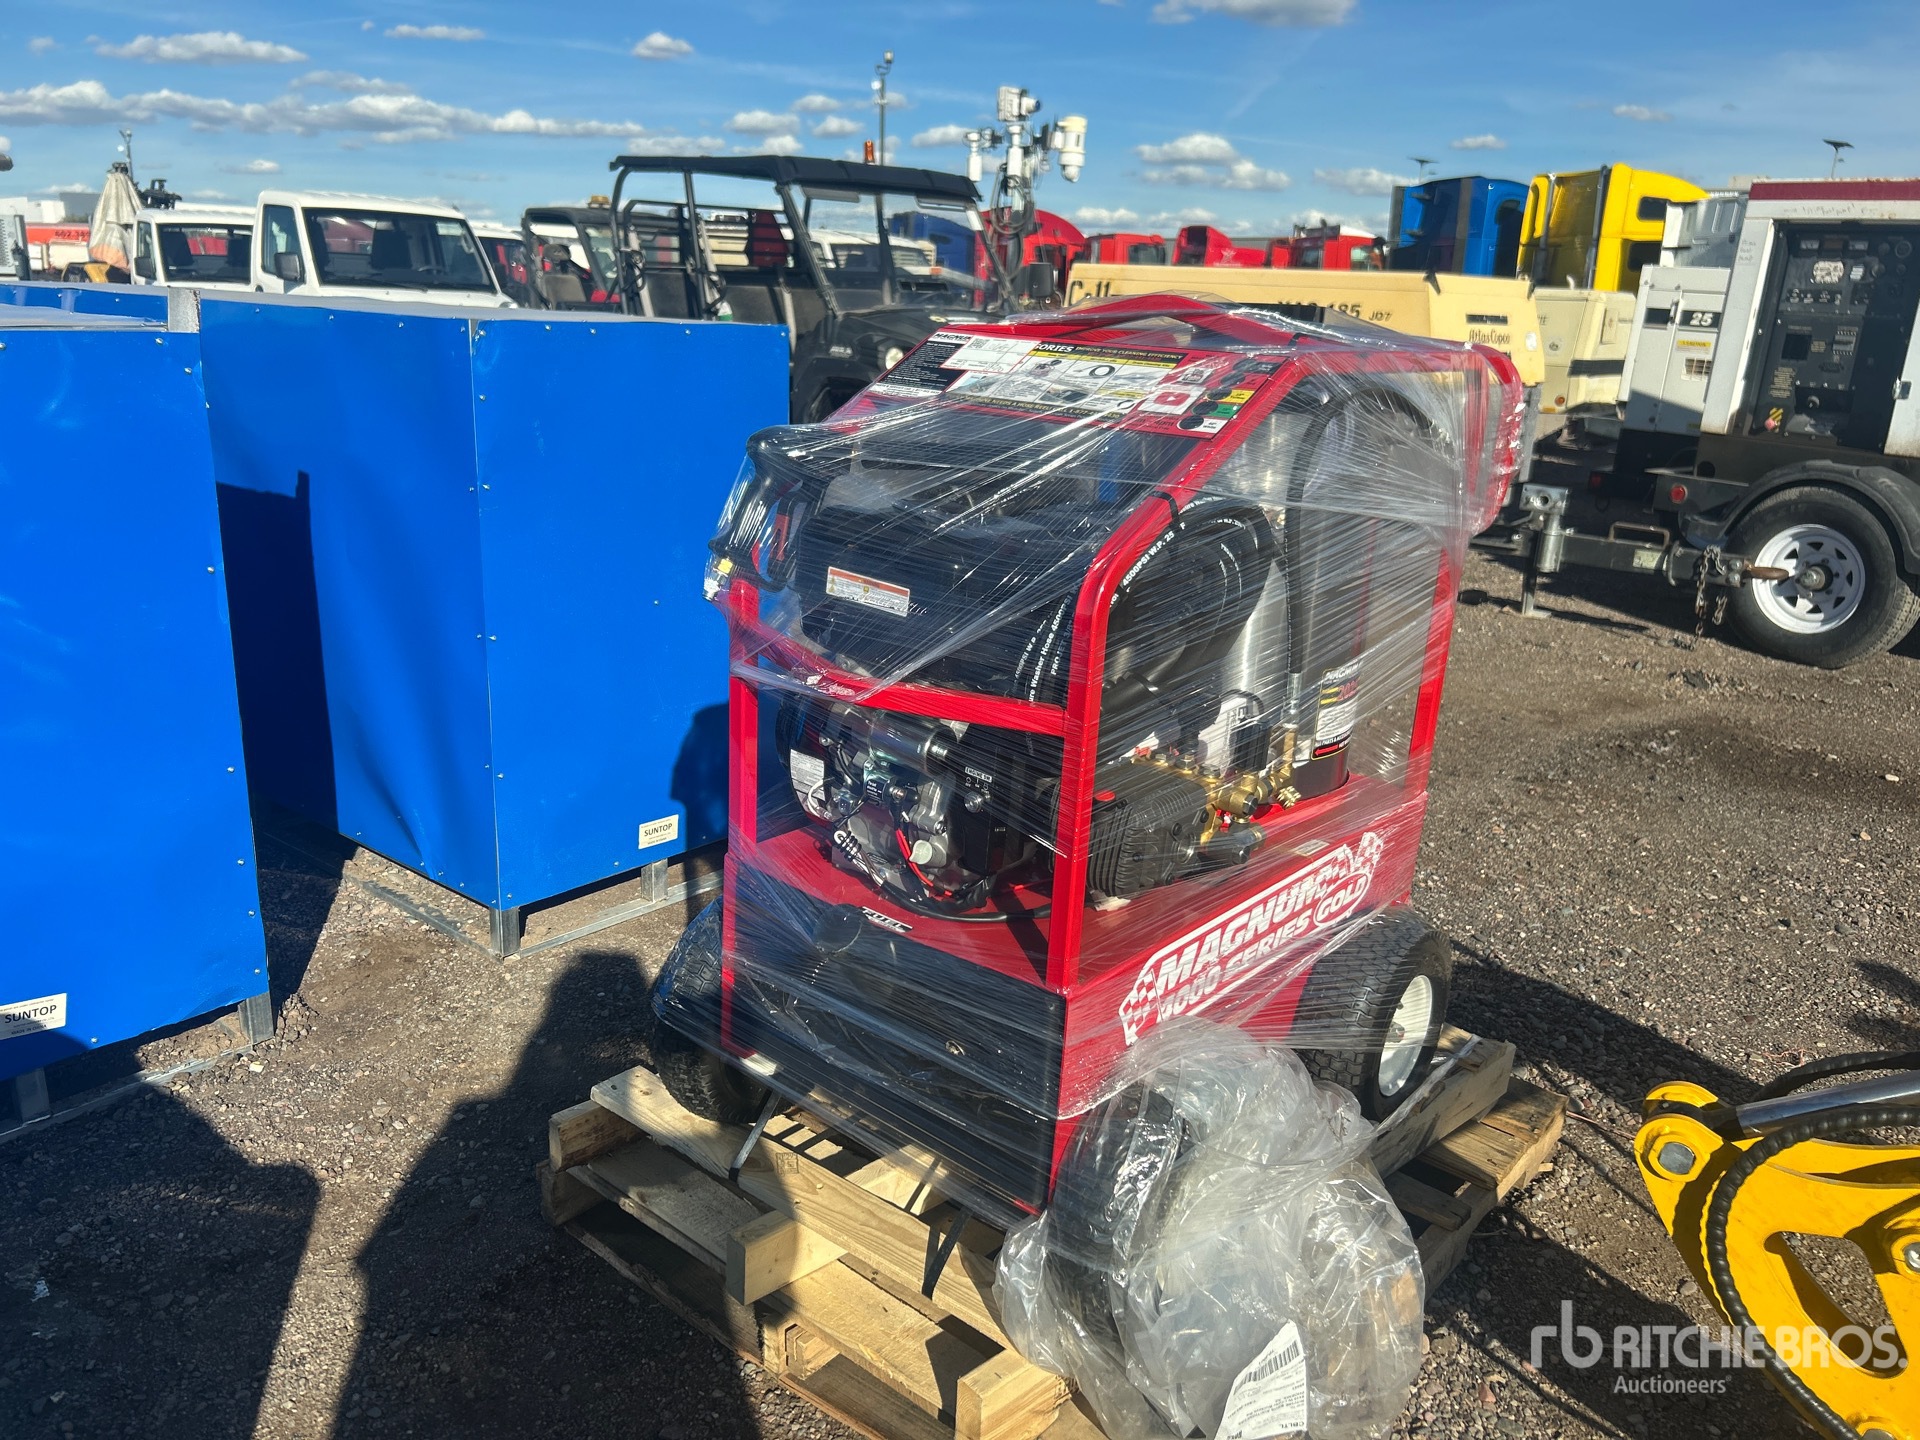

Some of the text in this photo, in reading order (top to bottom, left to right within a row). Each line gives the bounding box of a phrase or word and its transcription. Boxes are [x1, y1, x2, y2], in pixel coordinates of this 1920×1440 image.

[1069, 281, 1111, 306] Cll
[1690, 312, 1714, 327] 25
[1122, 553, 1150, 586] 4500PSI
[1030, 656, 1045, 688] Washer
[1040, 632, 1055, 656] Hose
[644, 822, 673, 837] SUNTOP
[1316, 876, 1368, 922] GOLD
[1156, 874, 1327, 992] MAGNUM
[1221, 909, 1313, 977] SERIES
[4, 1004, 58, 1024] SUNTOP
